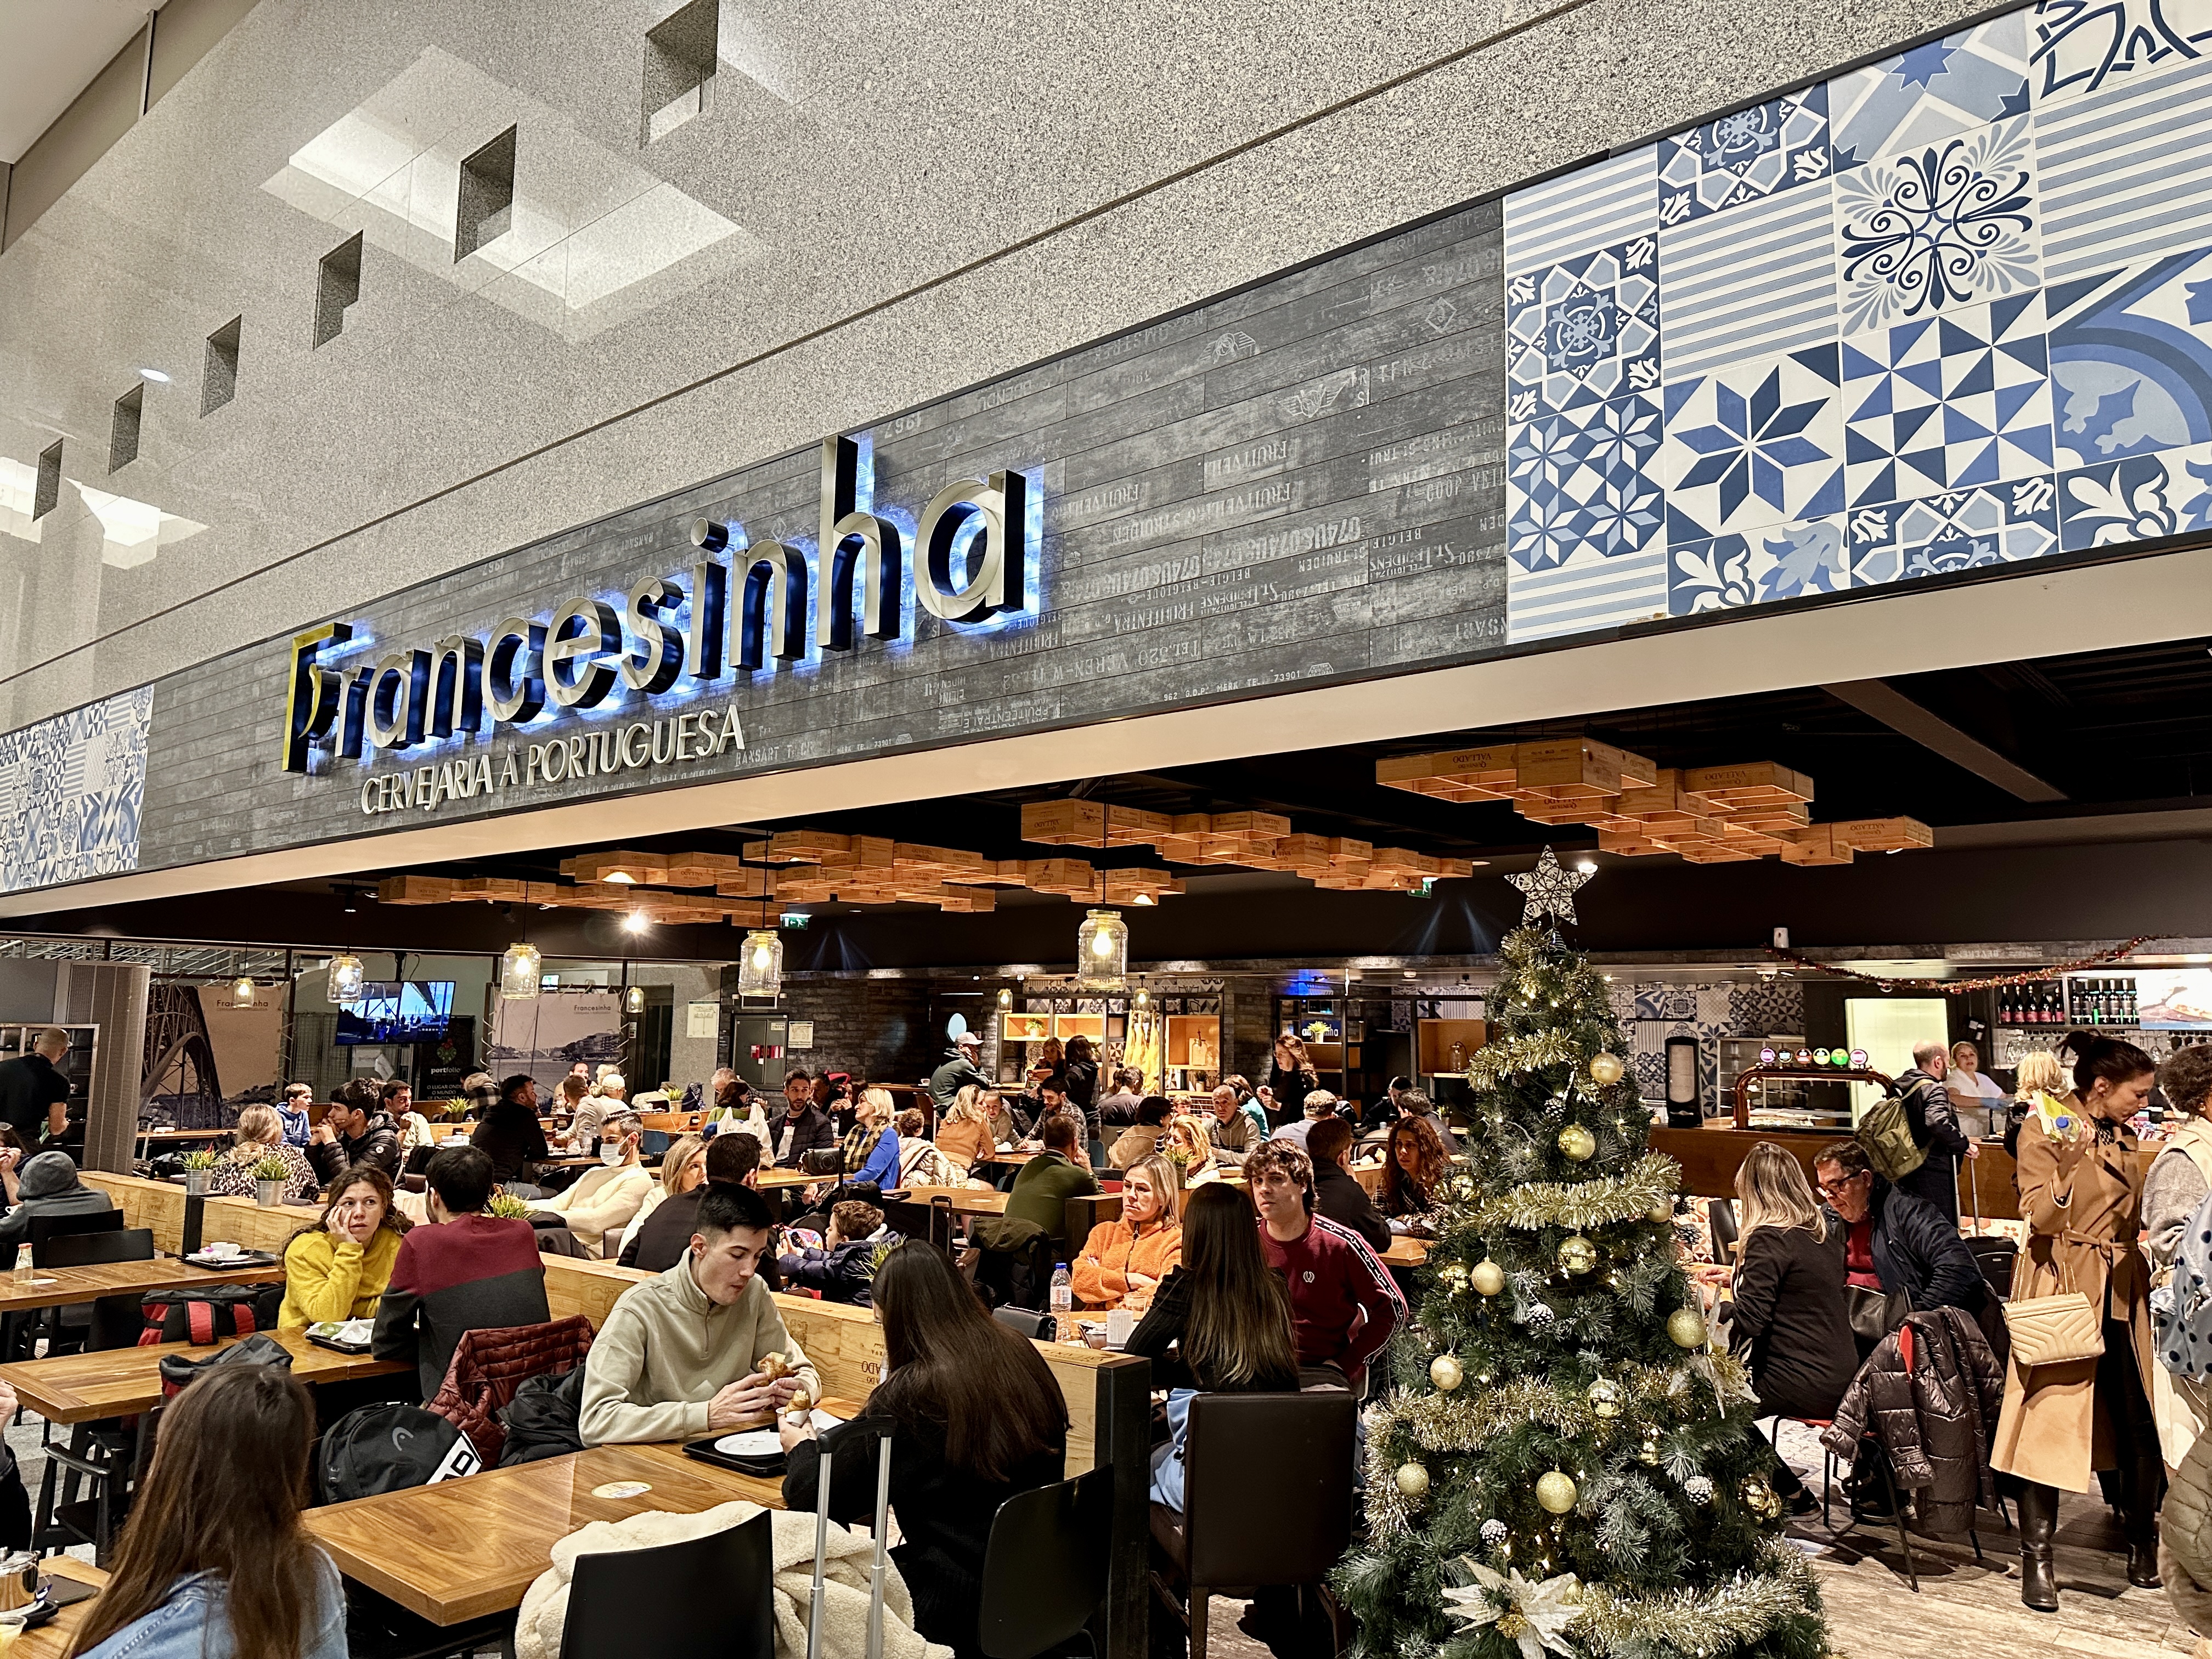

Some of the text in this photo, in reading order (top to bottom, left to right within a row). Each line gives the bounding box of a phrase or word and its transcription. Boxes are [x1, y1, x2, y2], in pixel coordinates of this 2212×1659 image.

[884, 409, 922, 439] 1967
[1438, 582, 1466, 599] MERK
[282, 435, 1031, 772] Francesinha
[1163, 691, 1177, 702] 962
[1216, 680, 1238, 692] MERK
[1273, 669, 1300, 682] 73901
[360, 704, 745, 817] CERVEJARIA À PORTUGUESA
[1453, 753, 1492, 763] VALLADO
[1704, 770, 1746, 781] VALLADO
[1850, 822, 1886, 831] VALLADO
[431, 1066, 461, 1075] portfolio
